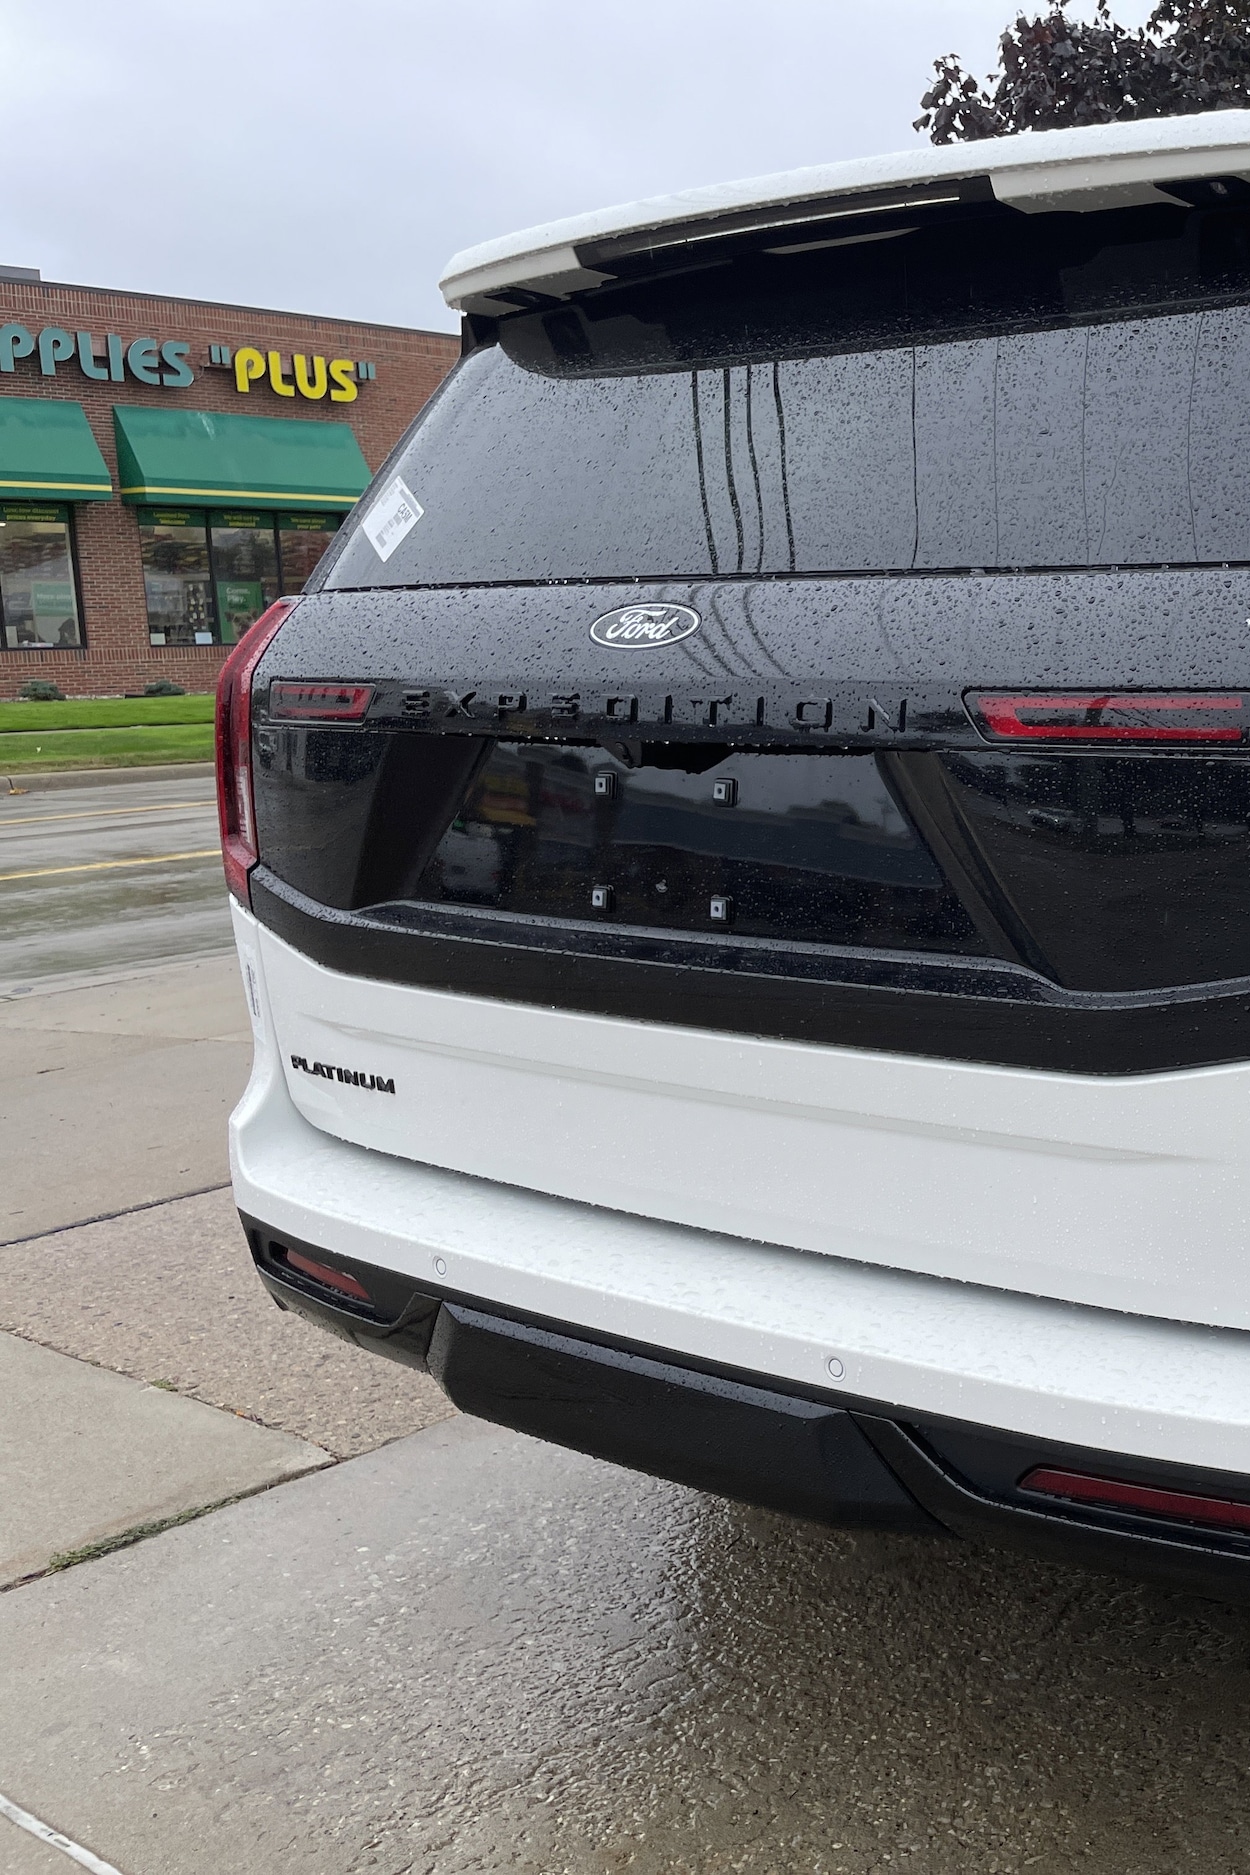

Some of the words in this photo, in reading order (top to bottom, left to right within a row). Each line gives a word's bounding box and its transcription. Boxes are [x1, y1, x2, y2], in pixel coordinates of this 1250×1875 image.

[605, 609, 679, 640] Ford
[402, 690, 907, 733] EXPEDITION
[290, 1054, 396, 1094] PLATINUM
